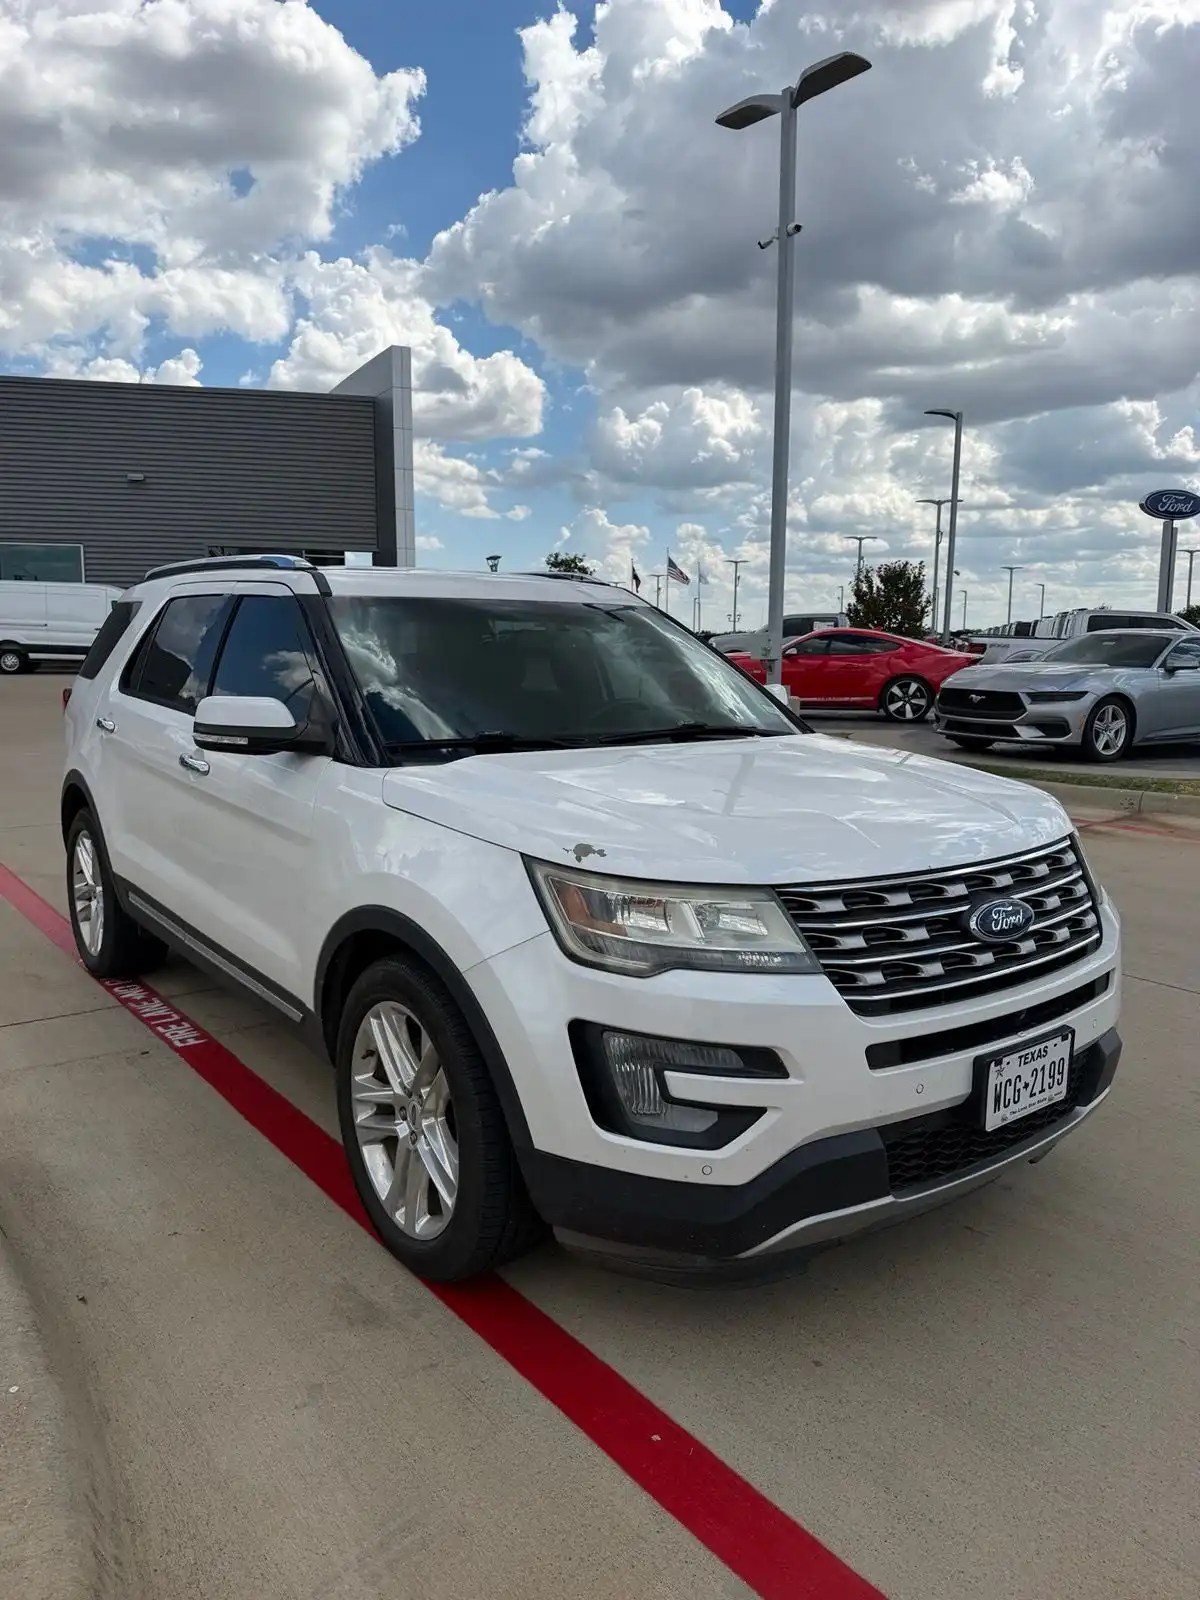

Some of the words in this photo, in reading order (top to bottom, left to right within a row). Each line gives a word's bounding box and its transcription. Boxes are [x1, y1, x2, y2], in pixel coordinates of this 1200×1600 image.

[1158, 494, 1193, 512] Ford
[992, 906, 1025, 931] Ford
[128, 997, 181, 1024] LANE
[156, 1021, 208, 1047] FIRE
[1018, 1045, 1048, 1067] TEXAS
